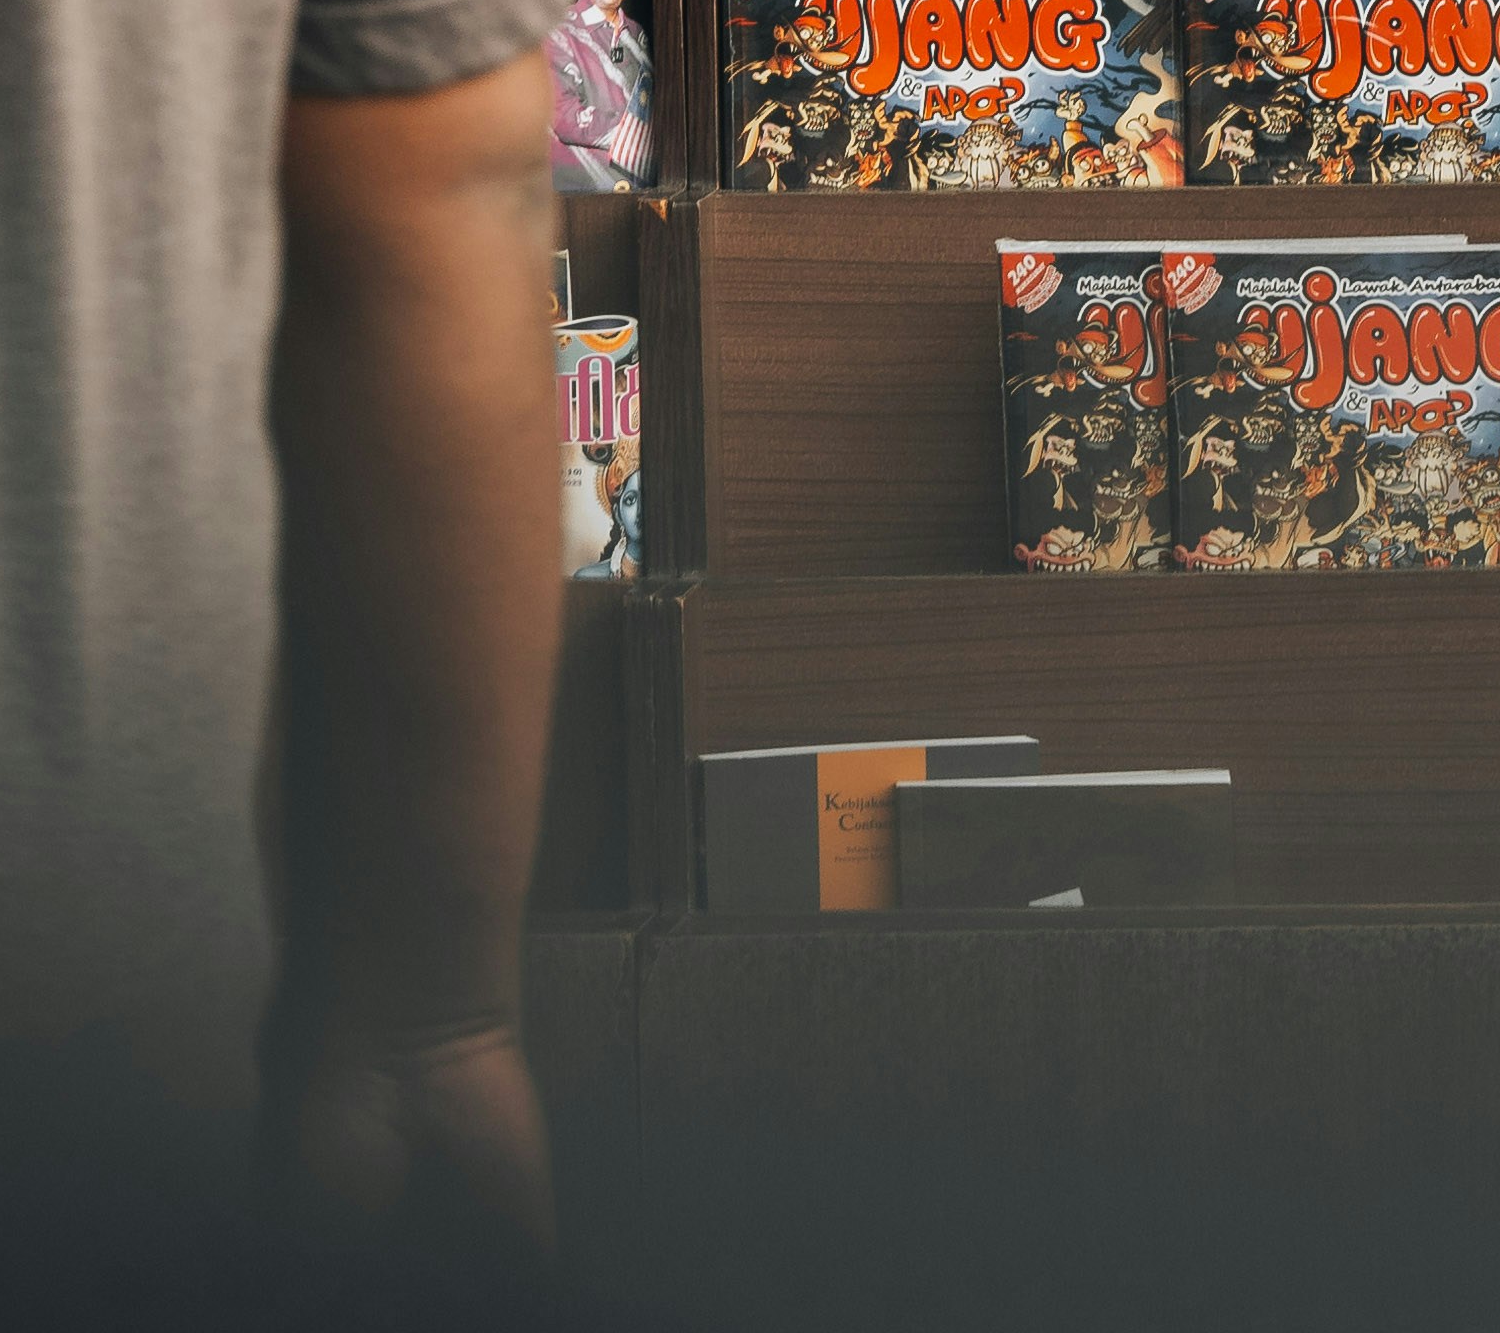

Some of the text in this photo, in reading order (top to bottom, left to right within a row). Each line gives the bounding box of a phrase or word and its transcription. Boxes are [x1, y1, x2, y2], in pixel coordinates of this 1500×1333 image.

[901, 80, 922, 98] &
[1363, 84, 1385, 101] &
[1008, 255, 1036, 285] 240
[1169, 257, 1196, 288] 240
[1077, 277, 1140, 294] Majalah
[1238, 278, 1300, 296] Majalah
[1342, 277, 1404, 294] Lawak
[1347, 391, 1368, 410] &
